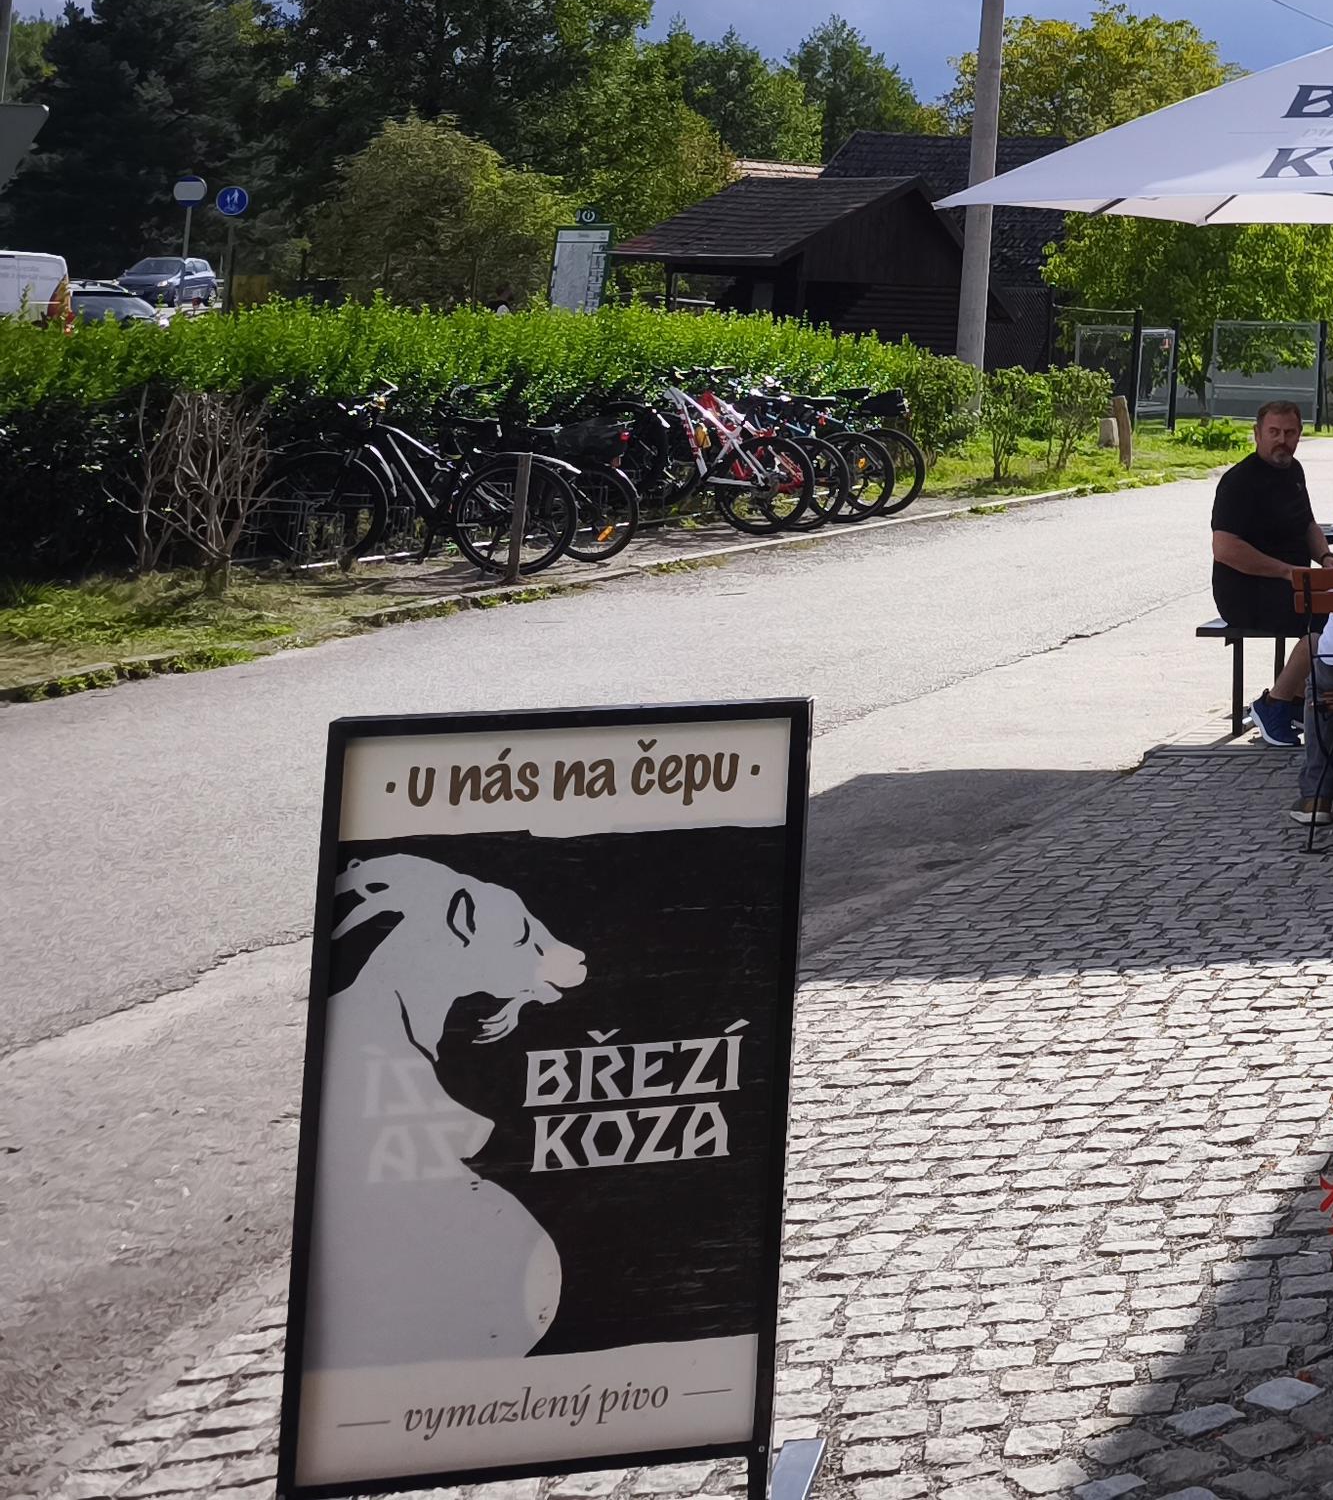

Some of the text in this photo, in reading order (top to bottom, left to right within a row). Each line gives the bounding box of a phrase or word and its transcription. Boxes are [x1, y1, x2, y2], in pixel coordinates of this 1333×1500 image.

[407, 739, 740, 807] u nás na čepu
[521, 1018, 752, 1108] BŘEZÍ
[529, 1101, 731, 1173] KOZA
[403, 1380, 670, 1442] vymazlený pivo
